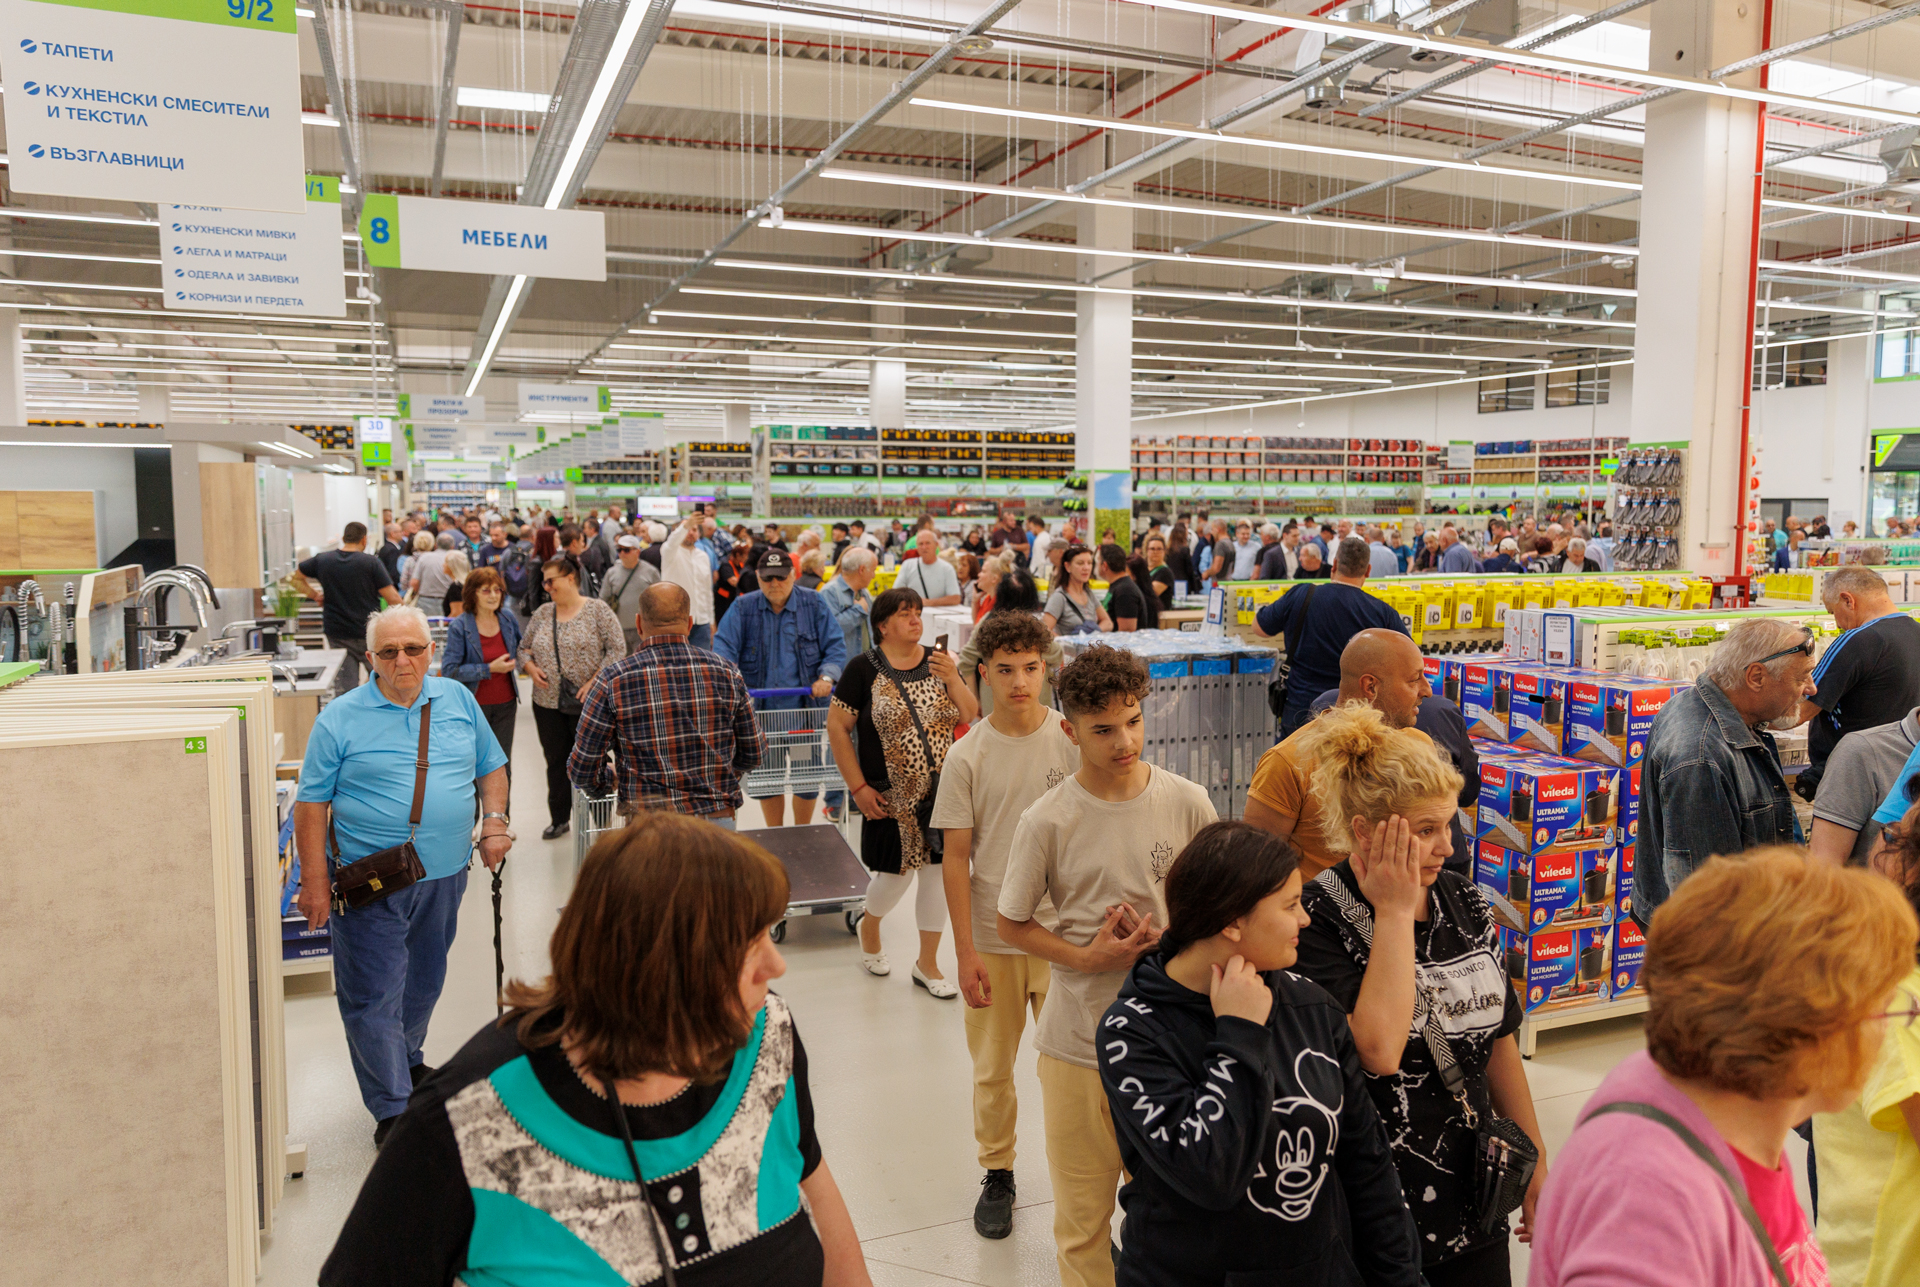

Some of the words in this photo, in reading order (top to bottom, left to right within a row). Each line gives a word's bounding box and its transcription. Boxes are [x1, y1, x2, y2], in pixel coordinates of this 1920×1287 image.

[227, 0, 274, 22] 9/2
[42, 42, 114, 62] ТАПЕТИ
[46, 84, 158, 108] КУХНЕНСКИ
[163, 97, 270, 119] СМЕСИТЕЛИ
[47, 105, 60, 118] И
[65, 107, 148, 127] ТЕКСТИЛ
[50, 147, 185, 171] ВЪЗГЛАВНИЦИ
[305, 181, 324, 197] /1
[185, 224, 253, 238] КУХНЕНСКИ
[256, 230, 296, 240] МИВКИ
[370, 217, 390, 244] 8
[462, 228, 548, 250] МЕБЕЛИ
[186, 248, 222, 258] ЛЕГЛА
[224, 250, 232, 258] И
[235, 251, 288, 262] МАТРАЦИ
[188, 270, 234, 281] ОДЕЯЛА
[236, 273, 245, 282] И
[248, 274, 300, 284] ЗАВИВКИ
[188, 292, 242, 304] КОРНИЗИ
[244, 296, 253, 304] И
[255, 296, 304, 306] ПЕРДЕТА
[528, 394, 588, 402] ИНСТРУМЕНТИ
[400, 400, 408, 411] 7
[368, 420, 384, 430] 3D
[1468, 674, 1486, 682] vileda
[1516, 682, 1536, 692] vileda
[1576, 692, 1596, 702] vileda
[1572, 704, 1594, 713] ULTRAMAX
[1483, 774, 1504, 785] vileda
[1542, 787, 1574, 797] vileda
[1536, 806, 1569, 816] ULTRAMAX
[1481, 852, 1501, 863] vileda
[1540, 866, 1572, 878] vileda
[1534, 886, 1566, 896] ULTRAMAX
[1623, 934, 1646, 944] vile
[300, 948, 328, 956] VELETTO
[1536, 944, 1568, 956] vileda
[1618, 952, 1646, 961] ULTRAMA
[1531, 964, 1563, 975] ULTRAMAX
